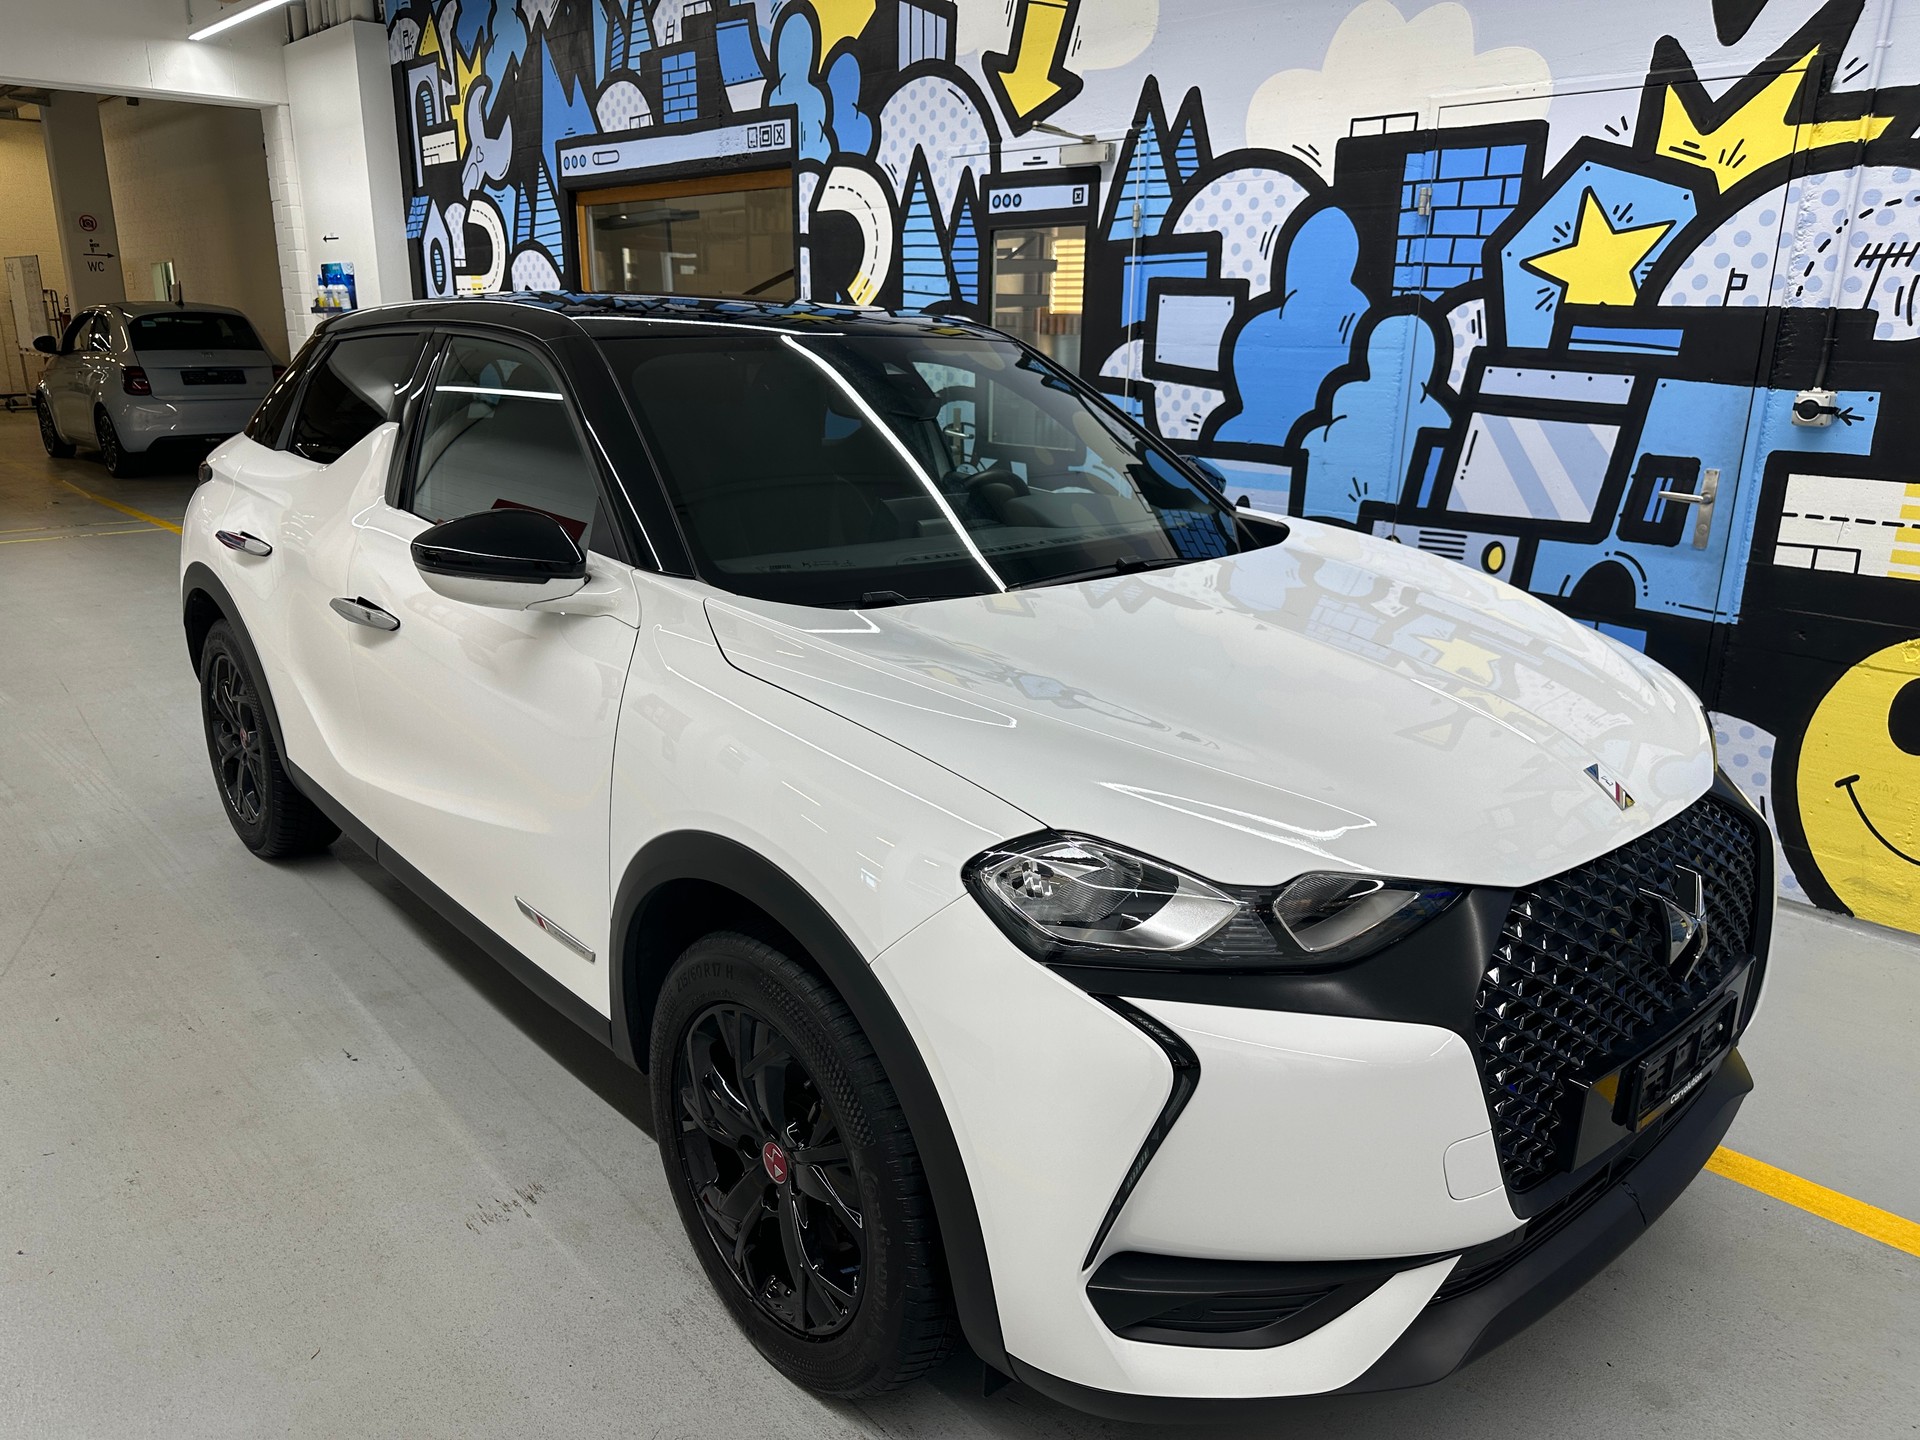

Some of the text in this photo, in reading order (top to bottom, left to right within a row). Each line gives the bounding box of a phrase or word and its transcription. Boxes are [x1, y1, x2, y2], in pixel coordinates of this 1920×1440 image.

[87, 261, 105, 272] WC
[677, 962, 734, 992] 215/60 R 17 H
